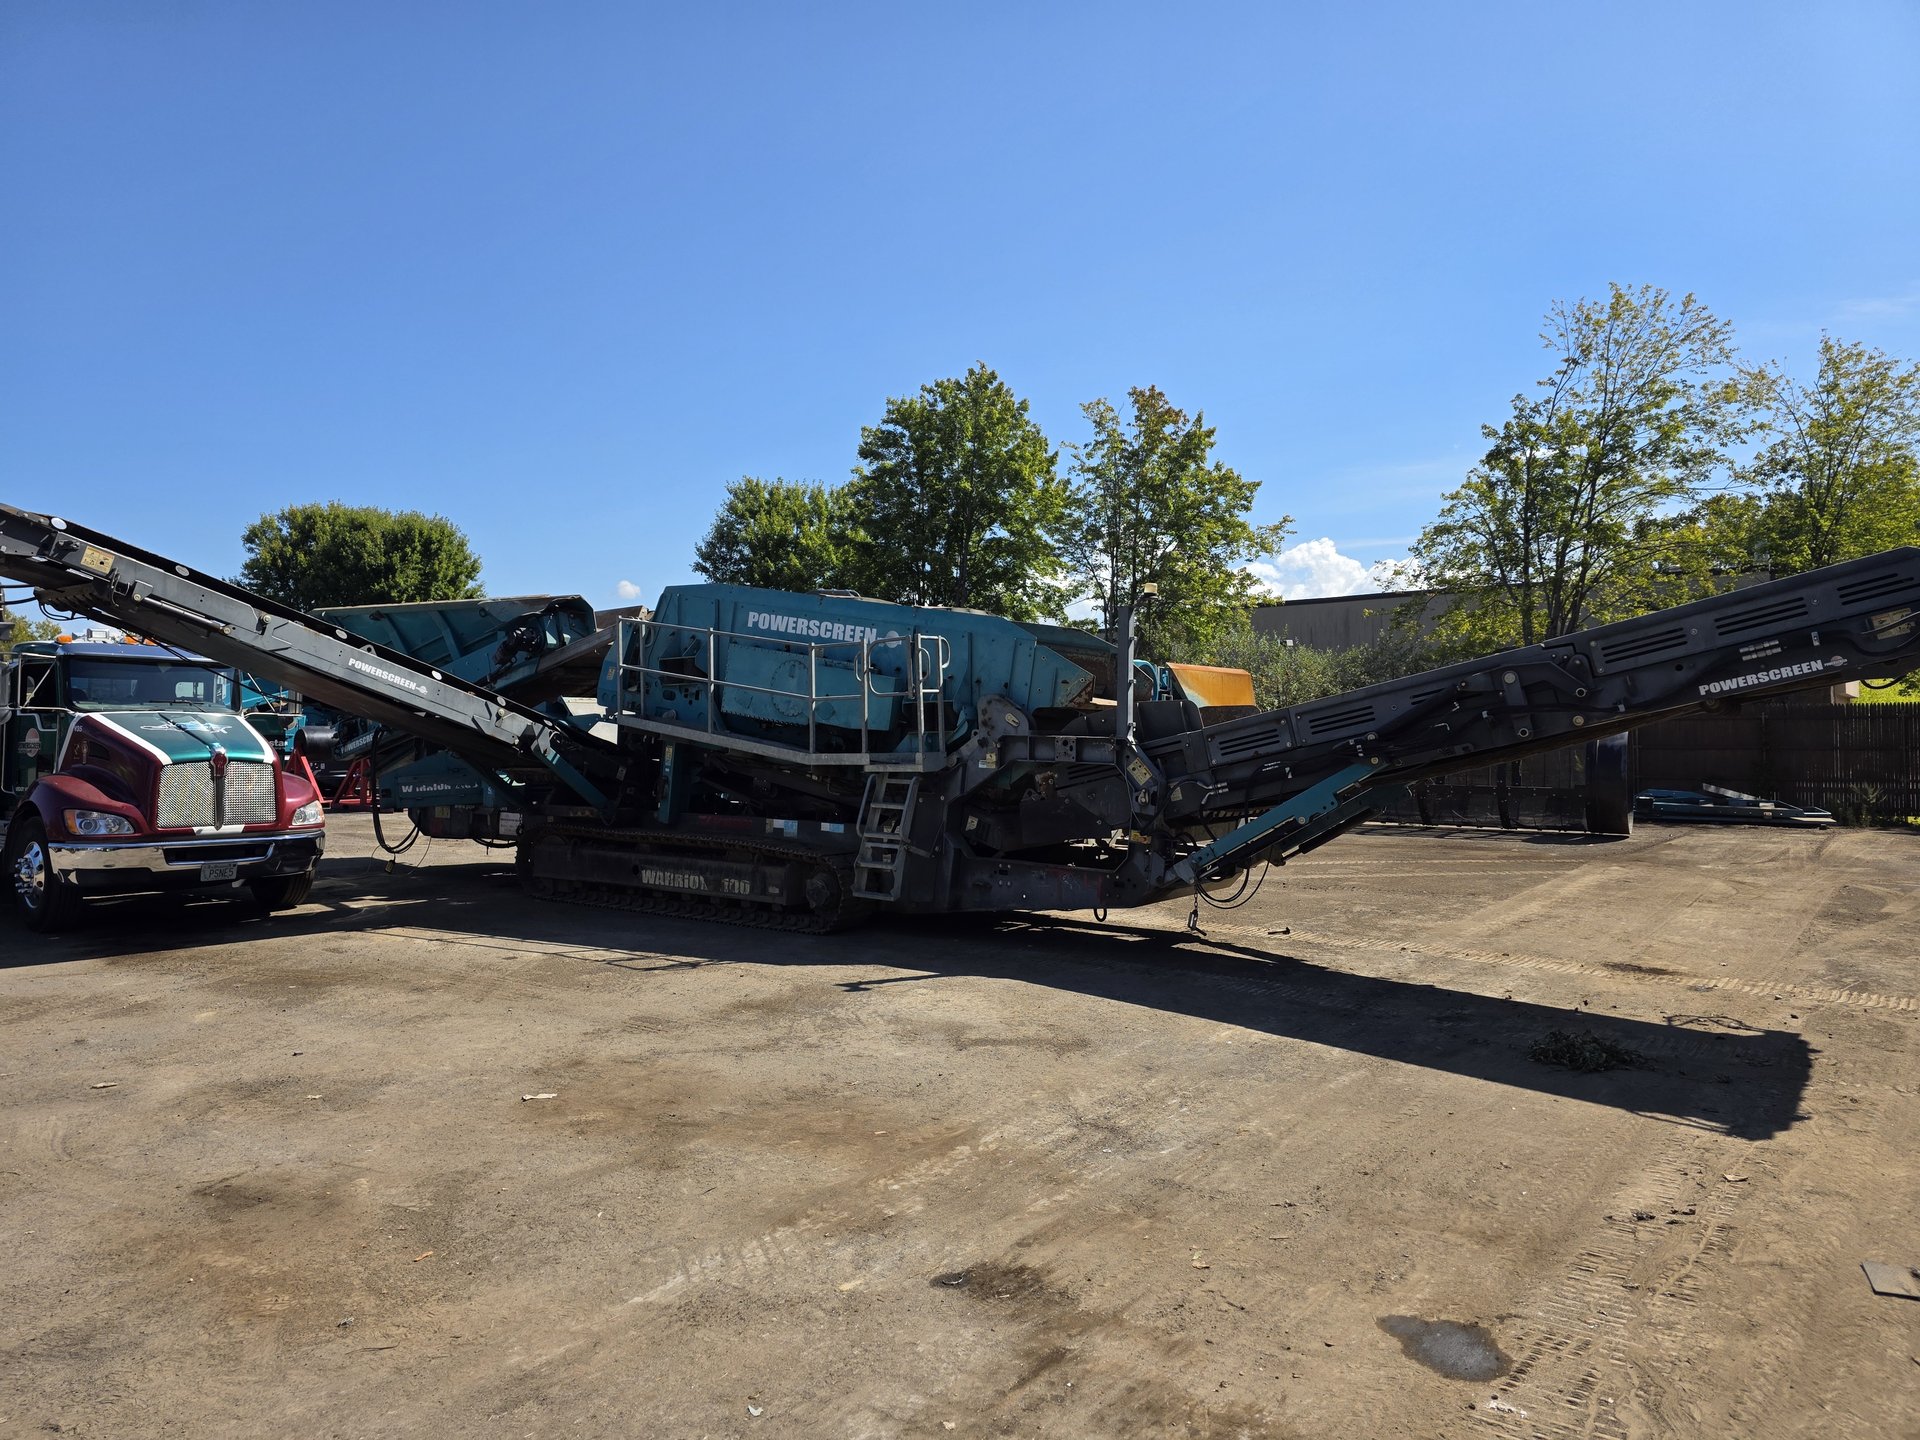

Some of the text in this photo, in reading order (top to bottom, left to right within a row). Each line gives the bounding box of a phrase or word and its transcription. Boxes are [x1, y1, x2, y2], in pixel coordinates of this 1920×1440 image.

[747, 611, 877, 643] POWERSCREEN
[348, 657, 417, 690] POWERSCREEN
[1698, 659, 1823, 695] POWERSCREEN
